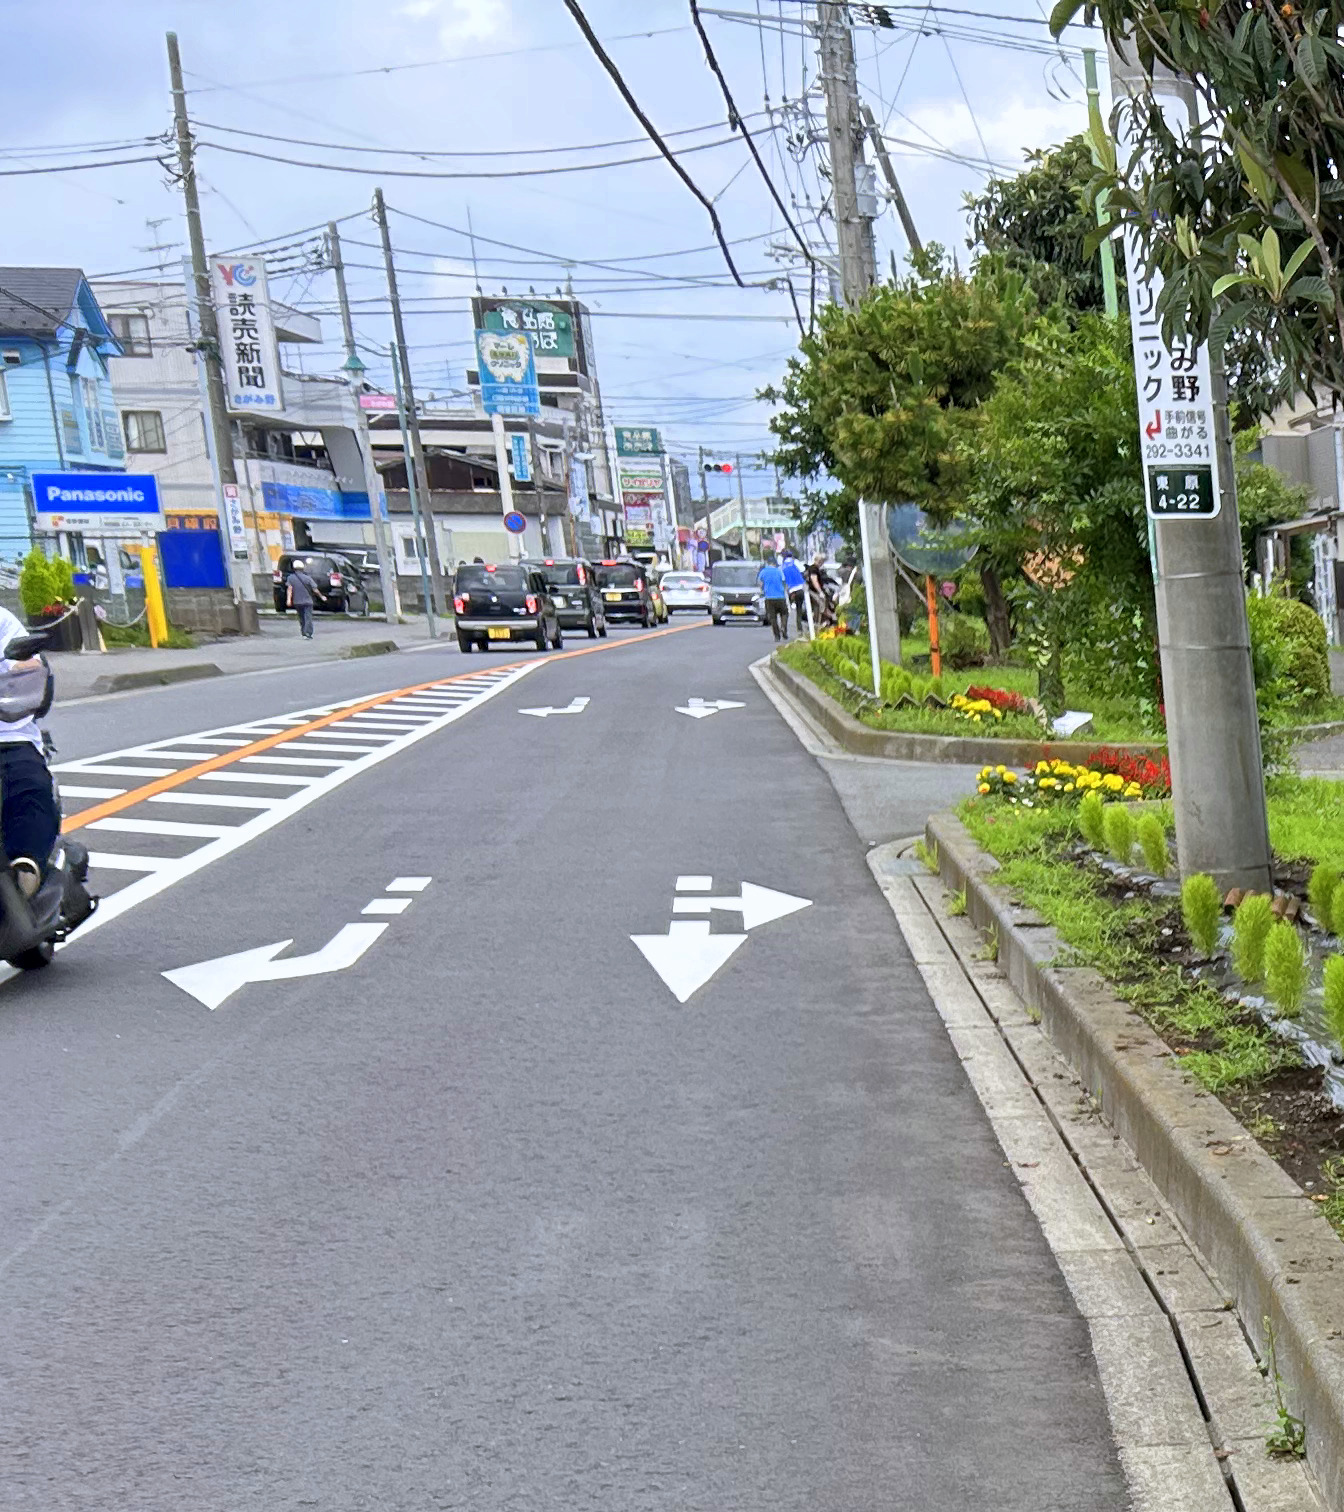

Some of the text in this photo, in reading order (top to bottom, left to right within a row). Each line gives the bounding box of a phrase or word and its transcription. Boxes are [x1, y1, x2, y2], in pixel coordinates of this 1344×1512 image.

[228, 293, 266, 389] 読売新聞
[1166, 426, 1208, 439] 曲がる
[1146, 444, 1210, 458] 292-3341
[47, 486, 144, 501] Panasonic
[1159, 494, 1200, 509] 4-22
